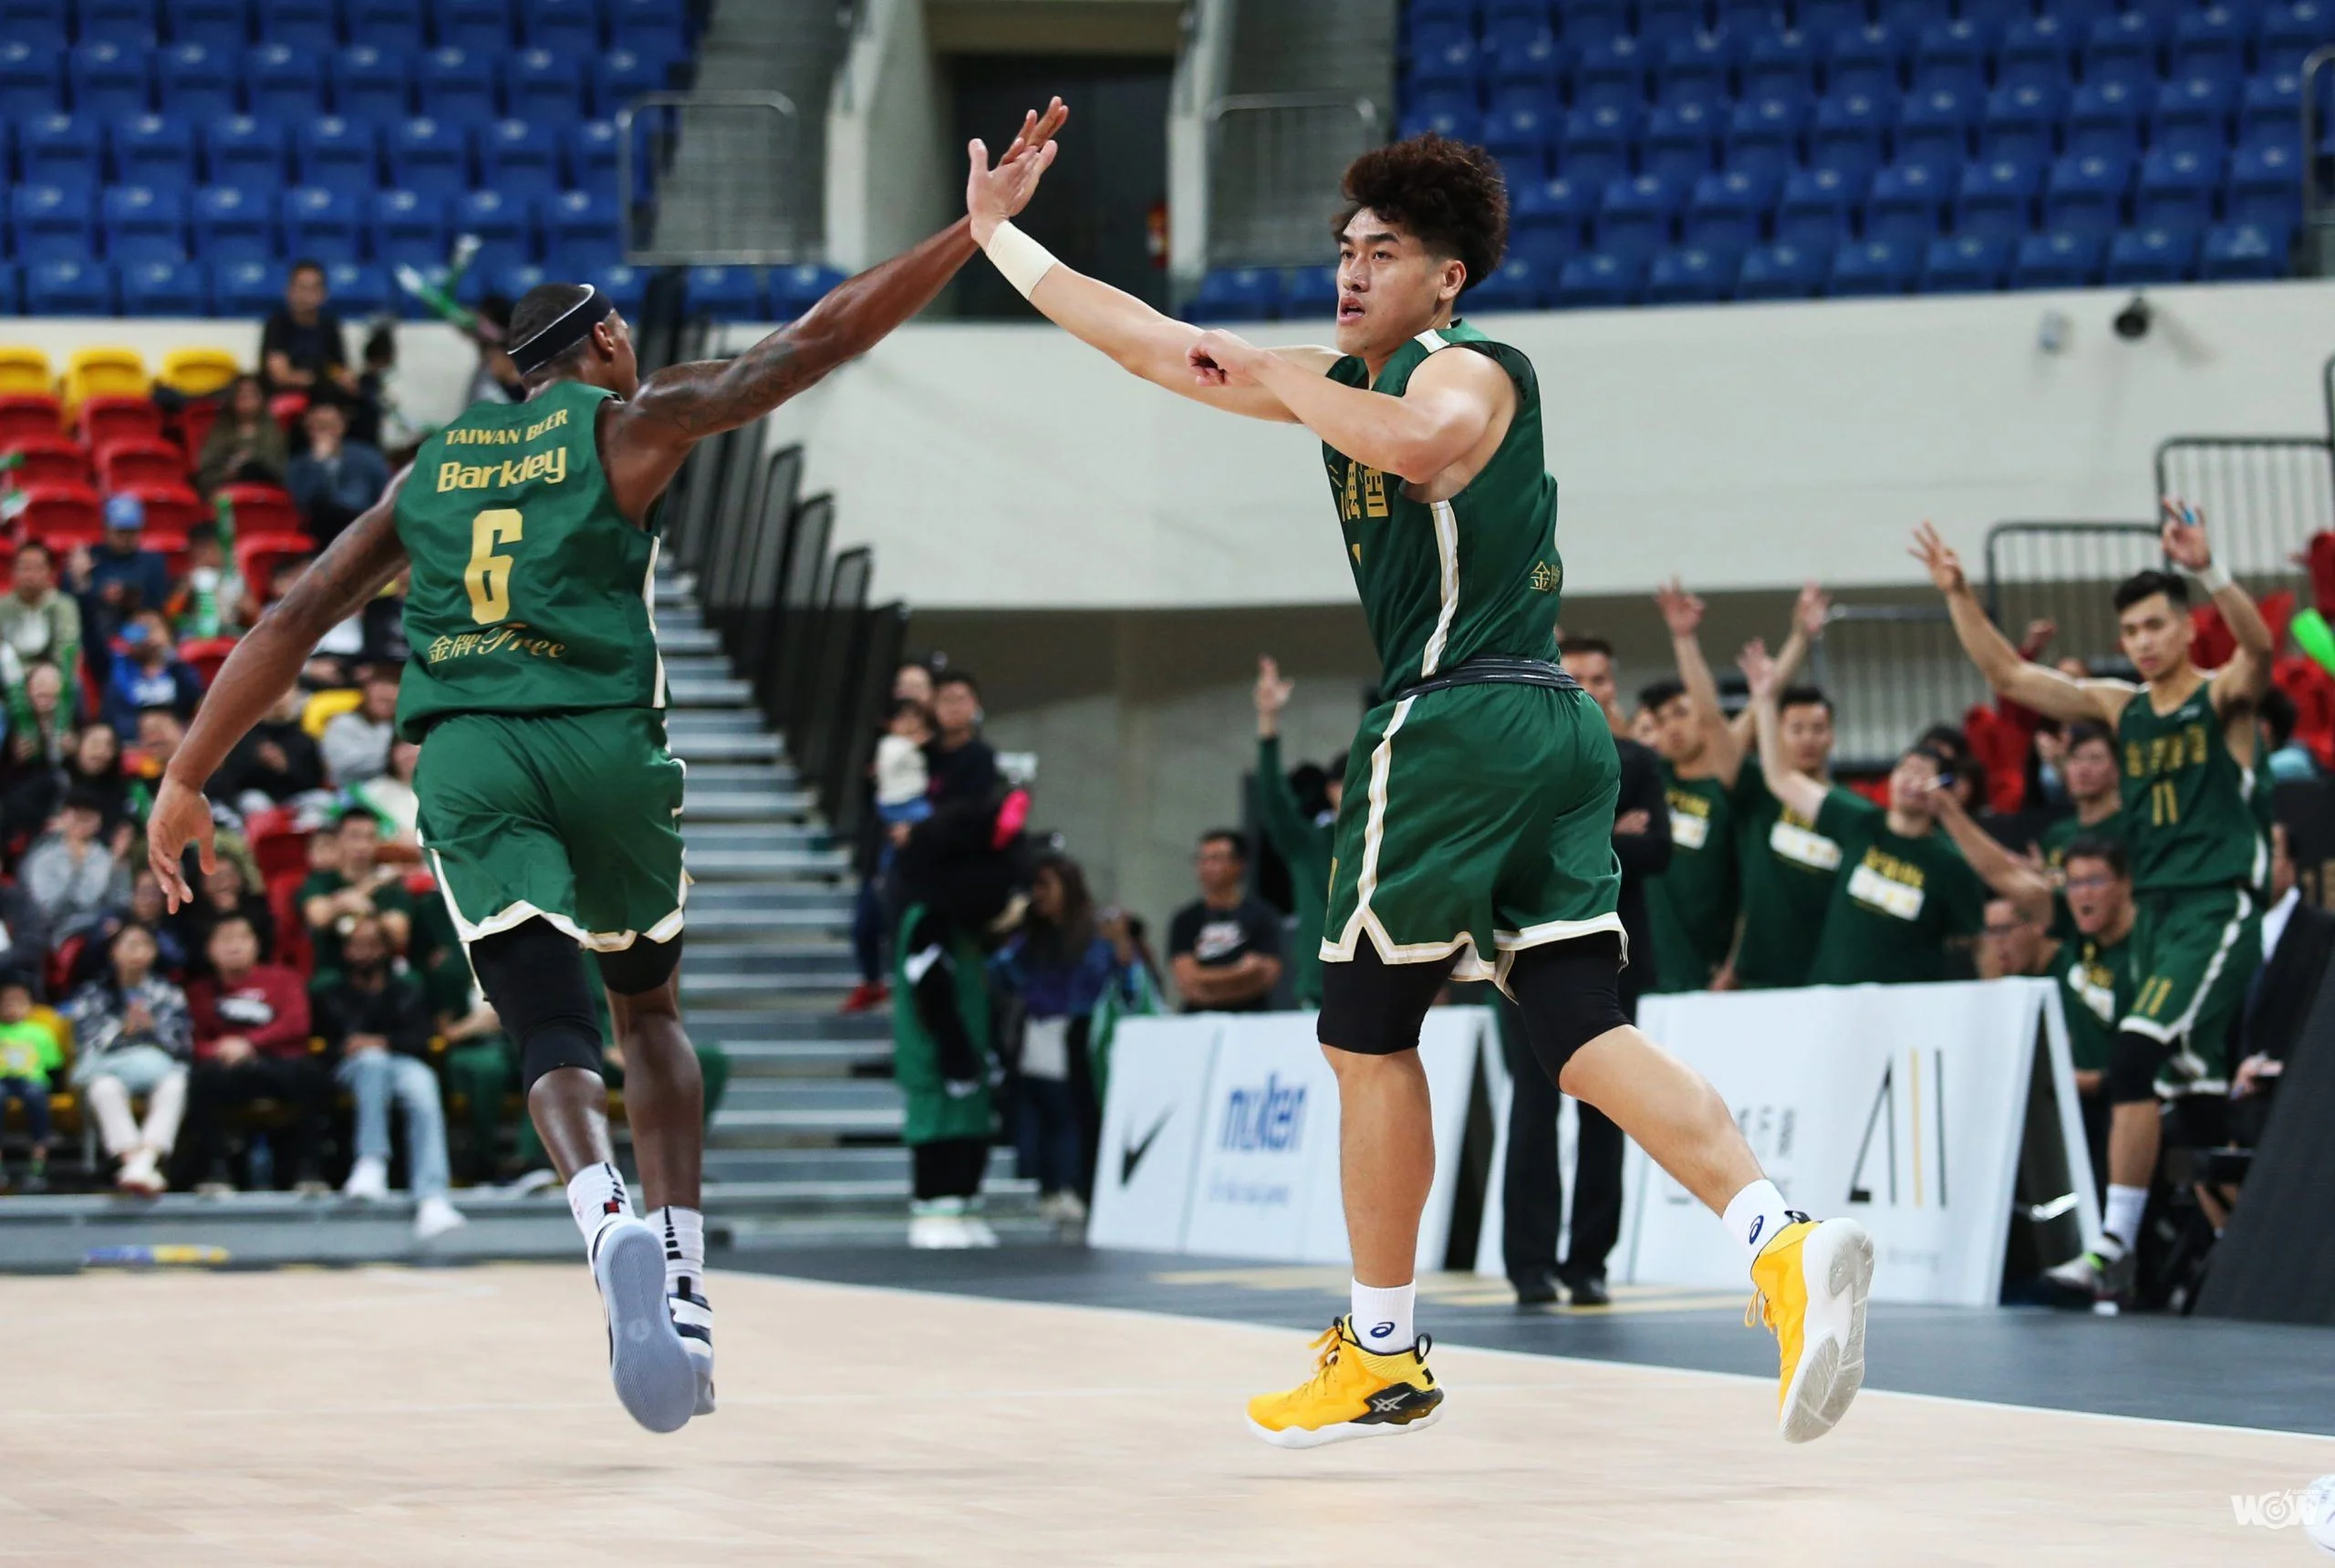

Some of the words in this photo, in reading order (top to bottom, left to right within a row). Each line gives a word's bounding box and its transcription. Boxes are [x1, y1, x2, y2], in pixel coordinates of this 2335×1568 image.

[445, 428, 522, 445] TAIWAN
[524, 408, 568, 441] BEER
[436, 446, 566, 493] Barkley
[463, 508, 524, 626] 6
